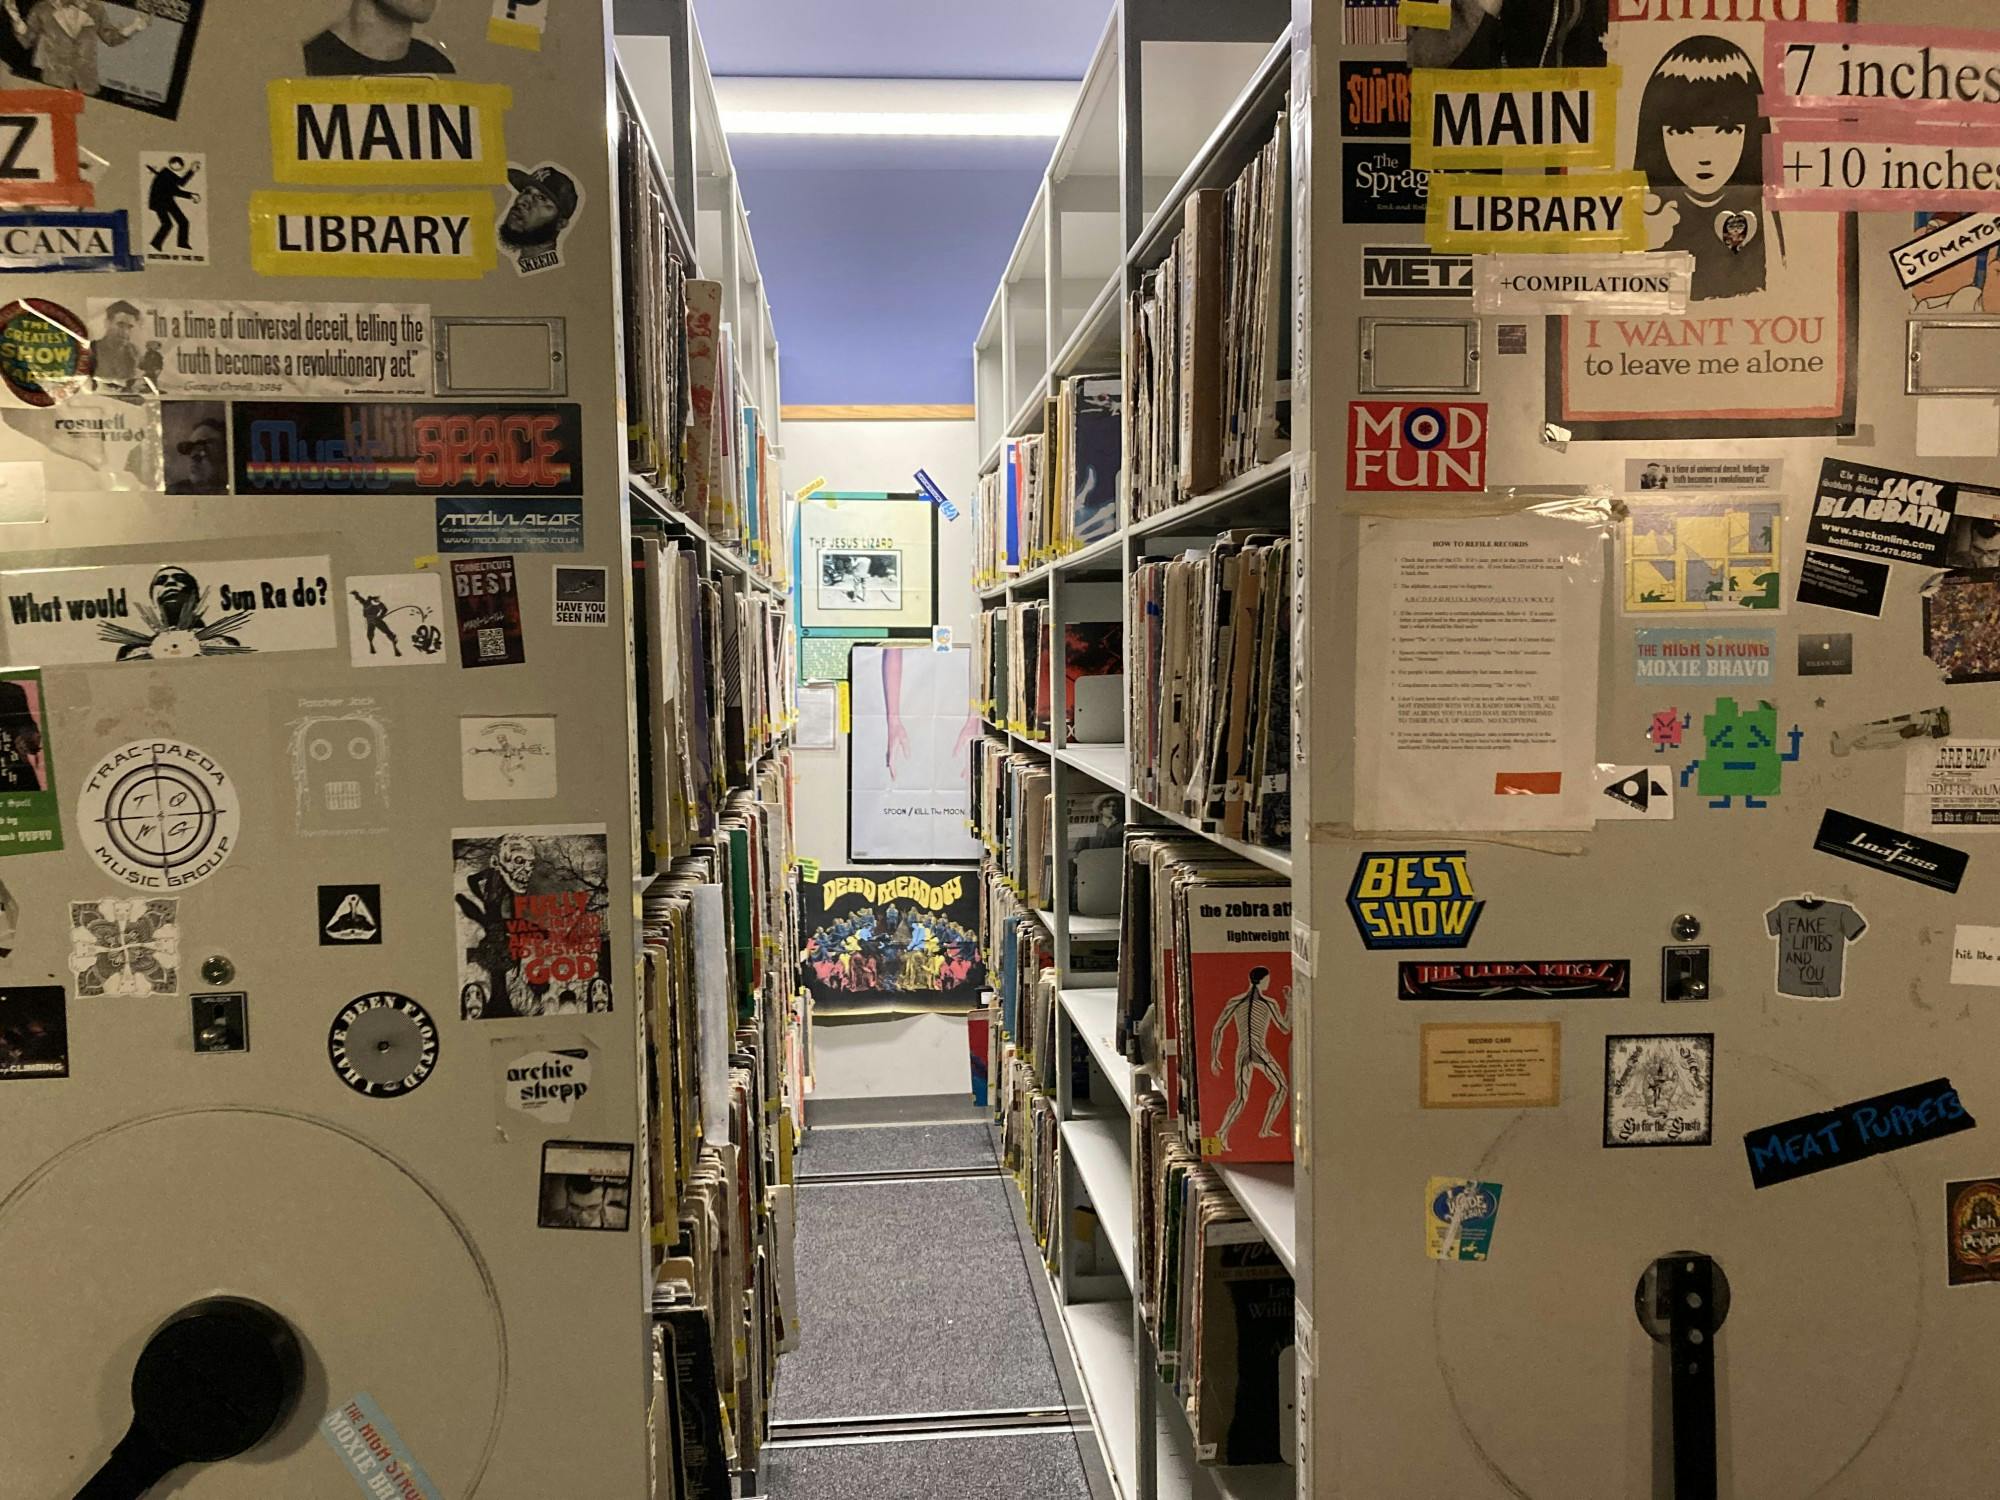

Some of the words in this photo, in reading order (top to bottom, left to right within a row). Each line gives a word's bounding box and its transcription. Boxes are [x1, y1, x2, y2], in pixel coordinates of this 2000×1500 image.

[1786, 44, 1816, 96] 7
[297, 104, 472, 160] MAIN
[1433, 91, 1589, 147] MAIN
[1373, 153, 1398, 169] The
[1783, 147, 1866, 190] +10
[1453, 196, 1623, 233] LIBRARY
[278, 215, 469, 254] LIBRARY
[519, 252, 559, 273] SKEEZO
[1501, 276, 1669, 292] +COMPILATIONS
[172, 317, 179, 338] a
[184, 310, 216, 338] time
[220, 312, 233, 339] of
[237, 312, 301, 341] universal
[306, 313, 352, 343] deceit,
[356, 313, 397, 346] telling
[401, 314, 423, 342] the
[1587, 321, 1600, 349] I
[1612, 320, 1732, 348] WANT
[1743, 317, 1823, 346] YOU
[0, 343, 72, 365] SHOW
[177, 347, 211, 374] truth
[215, 348, 281, 376] becomes
[284, 356, 293, 376] a
[297, 350, 386, 381] revolutionary
[1584, 355, 1613, 377] to
[1620, 352, 1690, 376] leave
[1698, 359, 1740, 376] me
[1748, 352, 1824, 375] alone
[1355, 405, 1484, 450] MOD
[414, 416, 560, 487] SPACE
[1355, 451, 1482, 487] FUN
[1877, 477, 1944, 507] SACK
[1815, 495, 1952, 535] BLABBATH
[809, 537, 826, 548] THE
[829, 538, 858, 549] JESUS
[862, 538, 894, 549] LIZARD
[1821, 523, 1935, 551] www.sackonline.com
[456, 571, 512, 597] BEST
[9, 593, 62, 625] What
[66, 588, 129, 622] would
[221, 584, 256, 611] Sun
[261, 582, 287, 609] Ra
[293, 577, 328, 607] do?
[556, 602, 582, 612] HAVE
[584, 602, 606, 613] YOU
[556, 612, 583, 623] SEEN
[585, 613, 606, 623] HIM
[1638, 644, 1657, 656] THE
[1663, 640, 1701, 657] HIGH
[1705, 640, 1770, 657] STRUNG
[1637, 660, 1702, 677] MOXIE
[1707, 660, 1769, 677] BRAVO
[883, 807, 906, 815] SPOON
[943, 808, 966, 816] MOON
[168, 836, 229, 887] GROUP
[1357, 857, 1474, 898] BEST
[515, 892, 589, 918] FULLY
[822, 877, 877, 911] DEAD
[877, 876, 963, 911] MEADOW
[1200, 905, 1221, 918] the
[1225, 903, 1269, 918] zebra
[1359, 900, 1476, 937] SHOW
[1227, 929, 1291, 943] lightweight
[1788, 917, 1826, 934] FAKE
[1792, 934, 1833, 952] LIMBS
[1955, 948, 1973, 961] hit
[1977, 951, 1994, 961] like
[526, 956, 597, 985] GOD
[1785, 951, 1812, 965] AND
[1797, 966, 1825, 983] YOU
[341, 996, 397, 1026] BEEN
[402, 1001, 436, 1088] FLOATED
[332, 1029, 362, 1085] HAVE
[506, 1060, 573, 1082] archie
[520, 1081, 588, 1103] shepp
[1752, 1119, 1842, 1172] MEAT
[1972, 1215, 1996, 1230] Jah
[344, 1402, 365, 1425] THE
[326, 1411, 377, 1475] MOXIE
